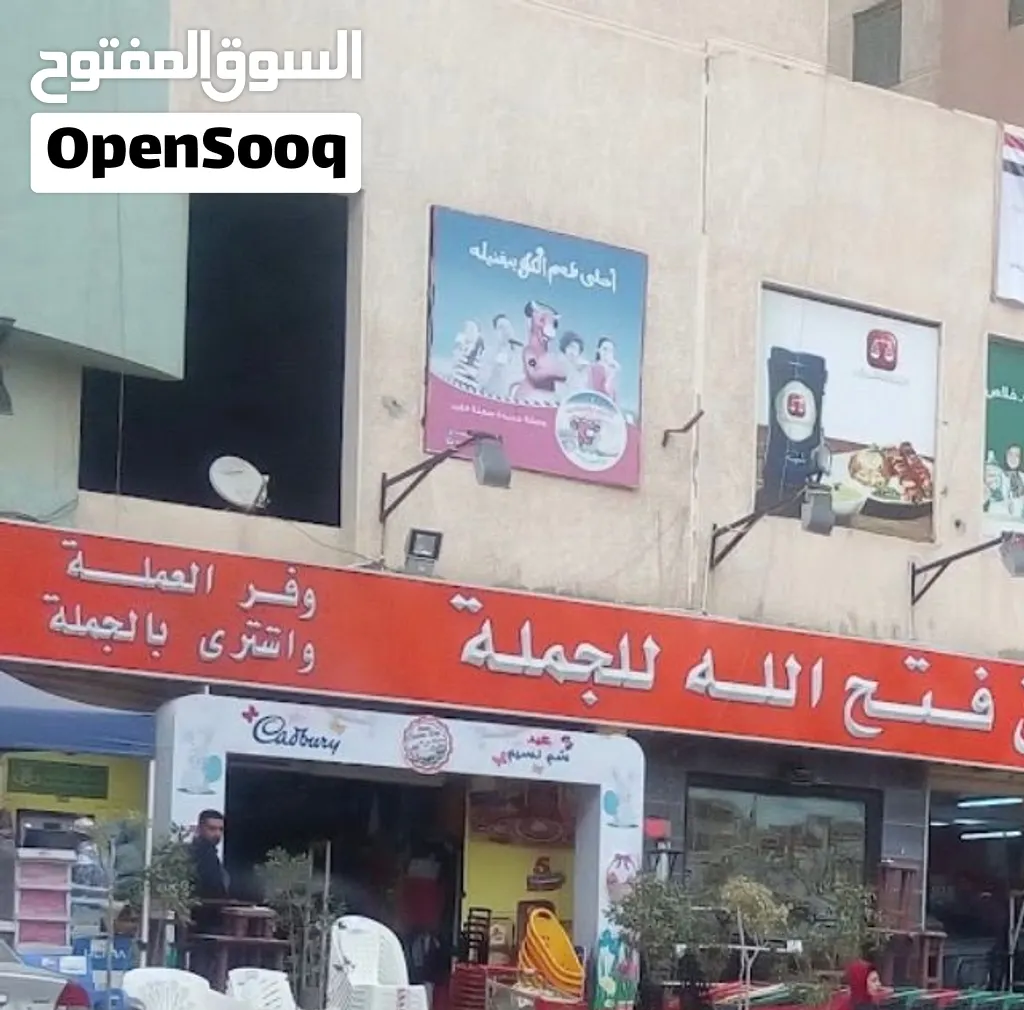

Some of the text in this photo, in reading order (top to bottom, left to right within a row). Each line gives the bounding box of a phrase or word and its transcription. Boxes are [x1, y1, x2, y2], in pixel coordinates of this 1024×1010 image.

[61, 539, 317, 620] وفر العملة
[43, 594, 168, 657] بالجملة
[450, 593, 661, 706] للجملة
[685, 648, 823, 709] الله
[843, 654, 995, 738] فتح
[252, 714, 344, 756] Cadbury
